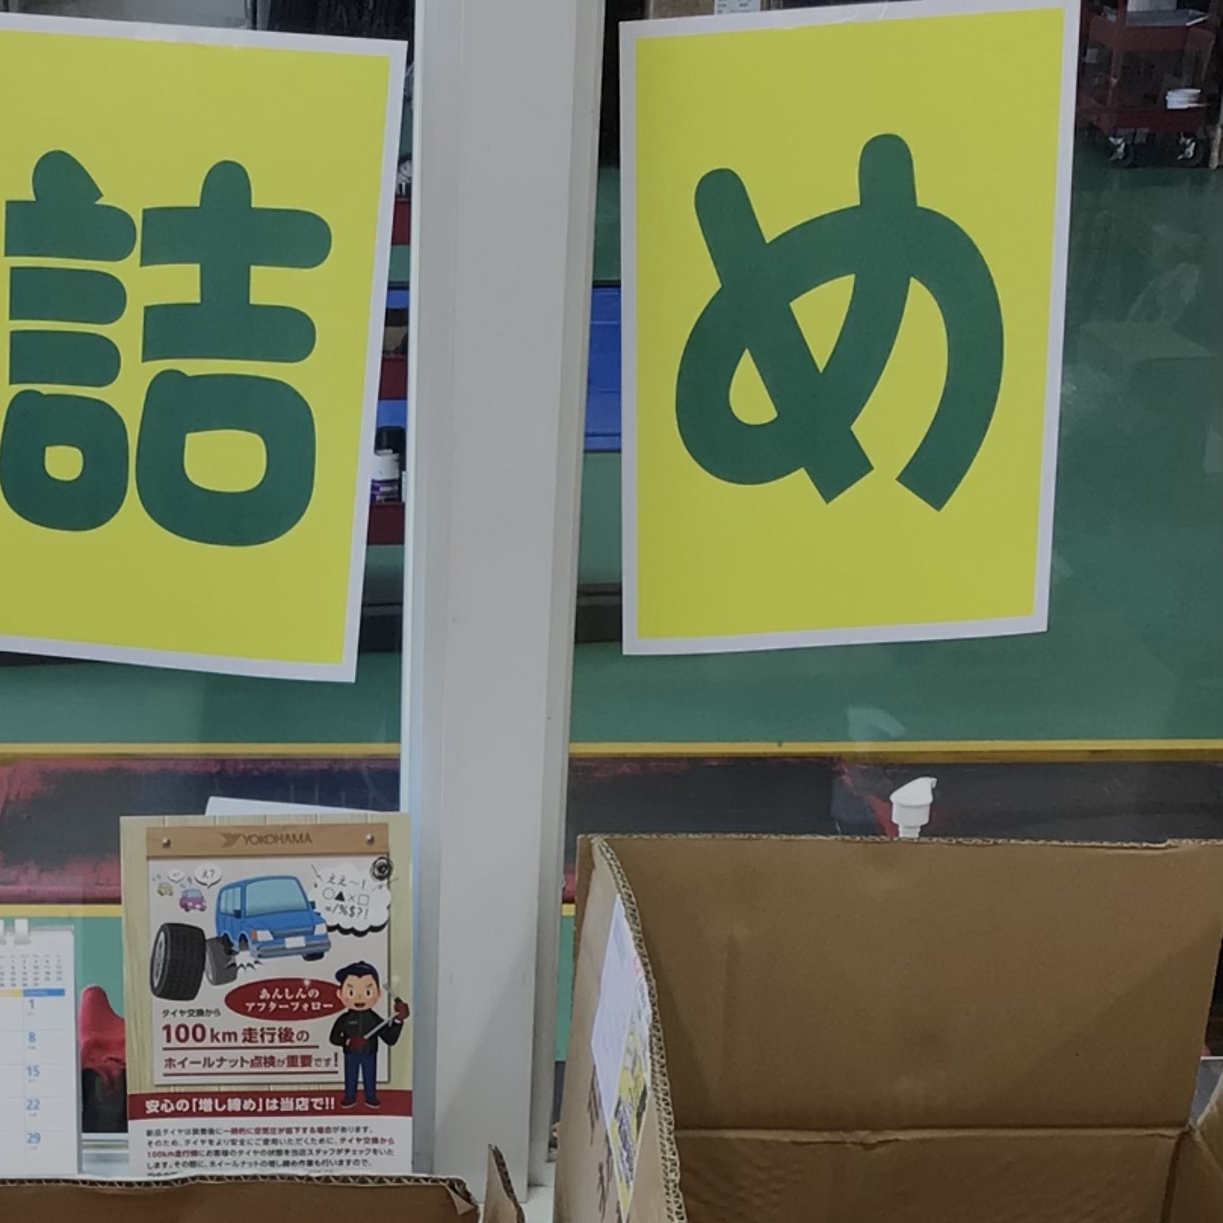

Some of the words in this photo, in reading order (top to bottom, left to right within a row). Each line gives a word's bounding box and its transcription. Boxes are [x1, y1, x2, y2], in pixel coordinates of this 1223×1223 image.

[243, 833, 312, 846] YOKOHAMA
[259, 988, 320, 999] あんしんの
[28, 999, 35, 1009] 1
[245, 1001, 334, 1012] アフターフォロー
[162, 1008, 221, 1018] タイヤ交換から
[28, 1032, 36, 1044] 8
[164, 1052, 338, 1069] ホイールナット点検が重要です!
[27, 1065, 40, 1077] 15
[26, 1099, 40, 1110] 22
[27, 1132, 41, 1144] 29
